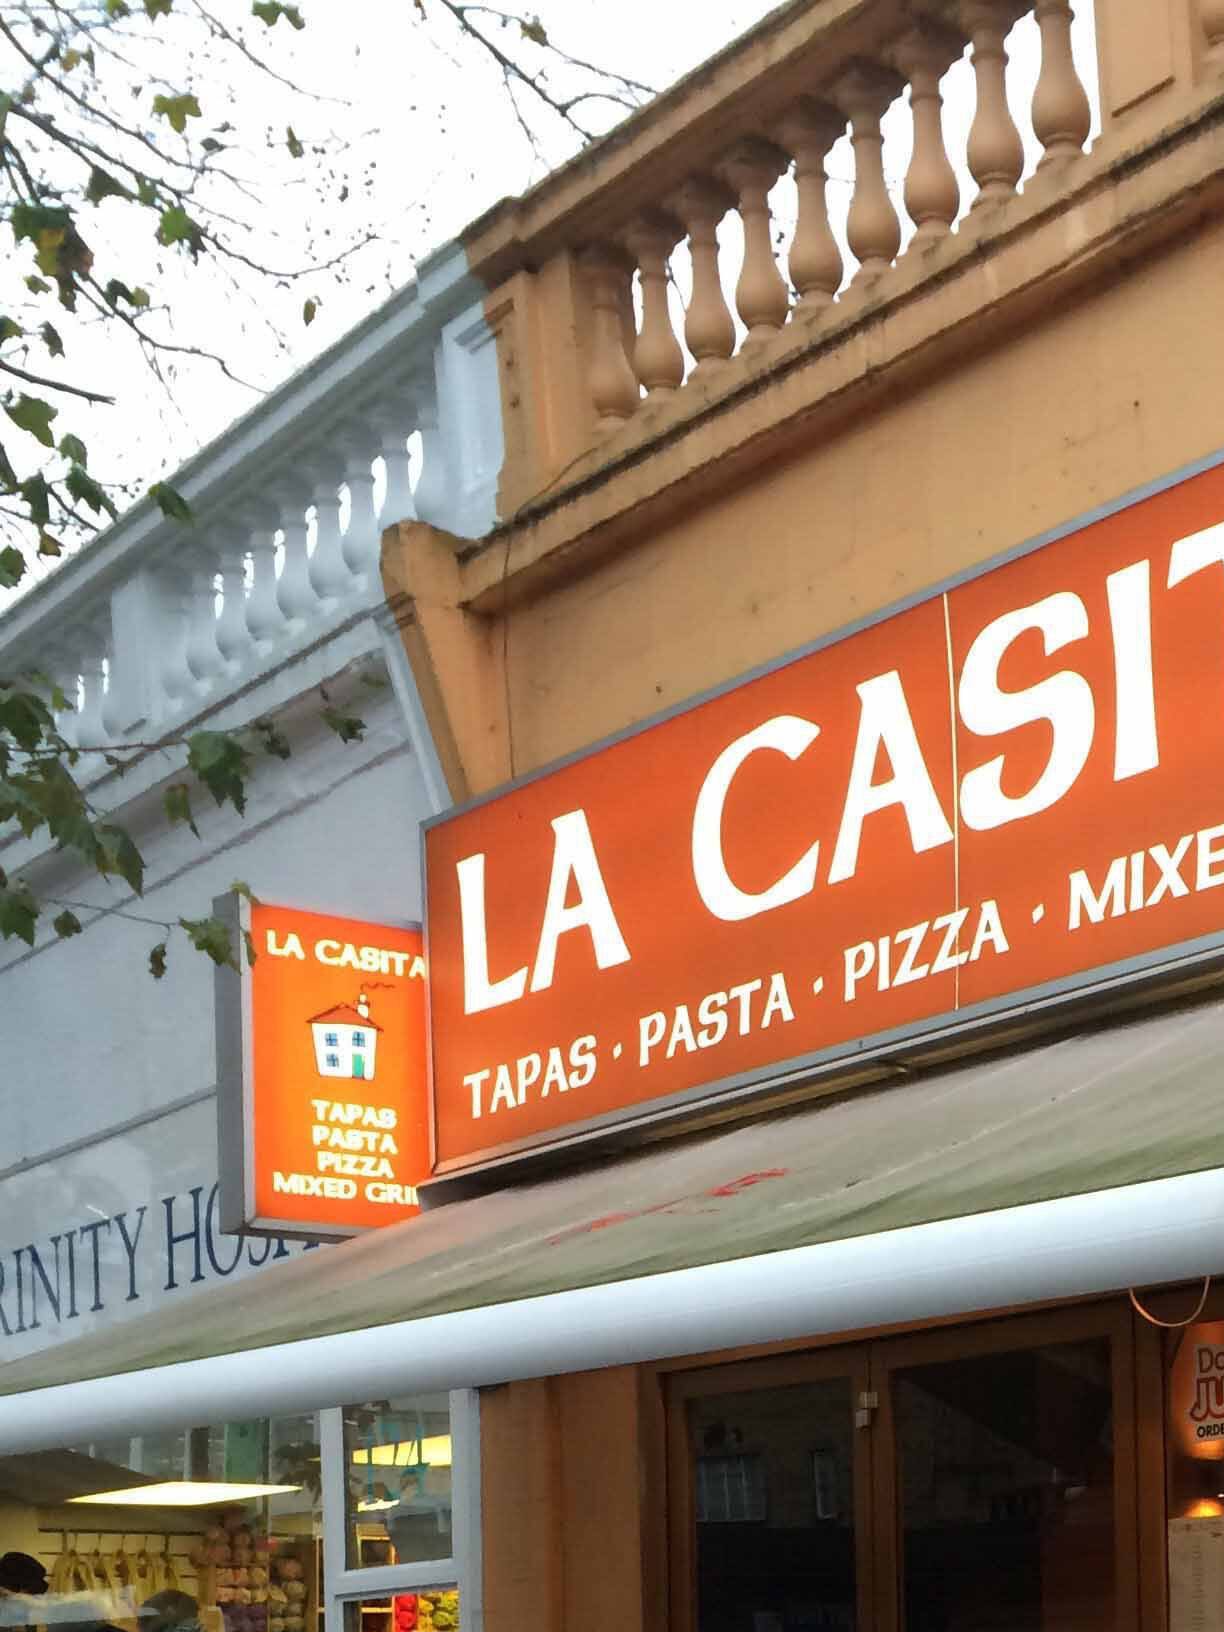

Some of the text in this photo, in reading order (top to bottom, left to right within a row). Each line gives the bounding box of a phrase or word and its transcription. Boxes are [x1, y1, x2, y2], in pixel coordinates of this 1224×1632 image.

[456, 809, 631, 1015] LA
[266, 929, 426, 978] LA CASITA
[463, 1035, 596, 1119] TAPAS
[639, 973, 795, 1067] PASTA
[844, 900, 1009, 1002] PIZZA
[311, 1099, 397, 1129] TAPAS
[312, 1125, 398, 1154] PASTA
[317, 1151, 394, 1179] PIZZA
[273, 1171, 357, 1199] MIXED
